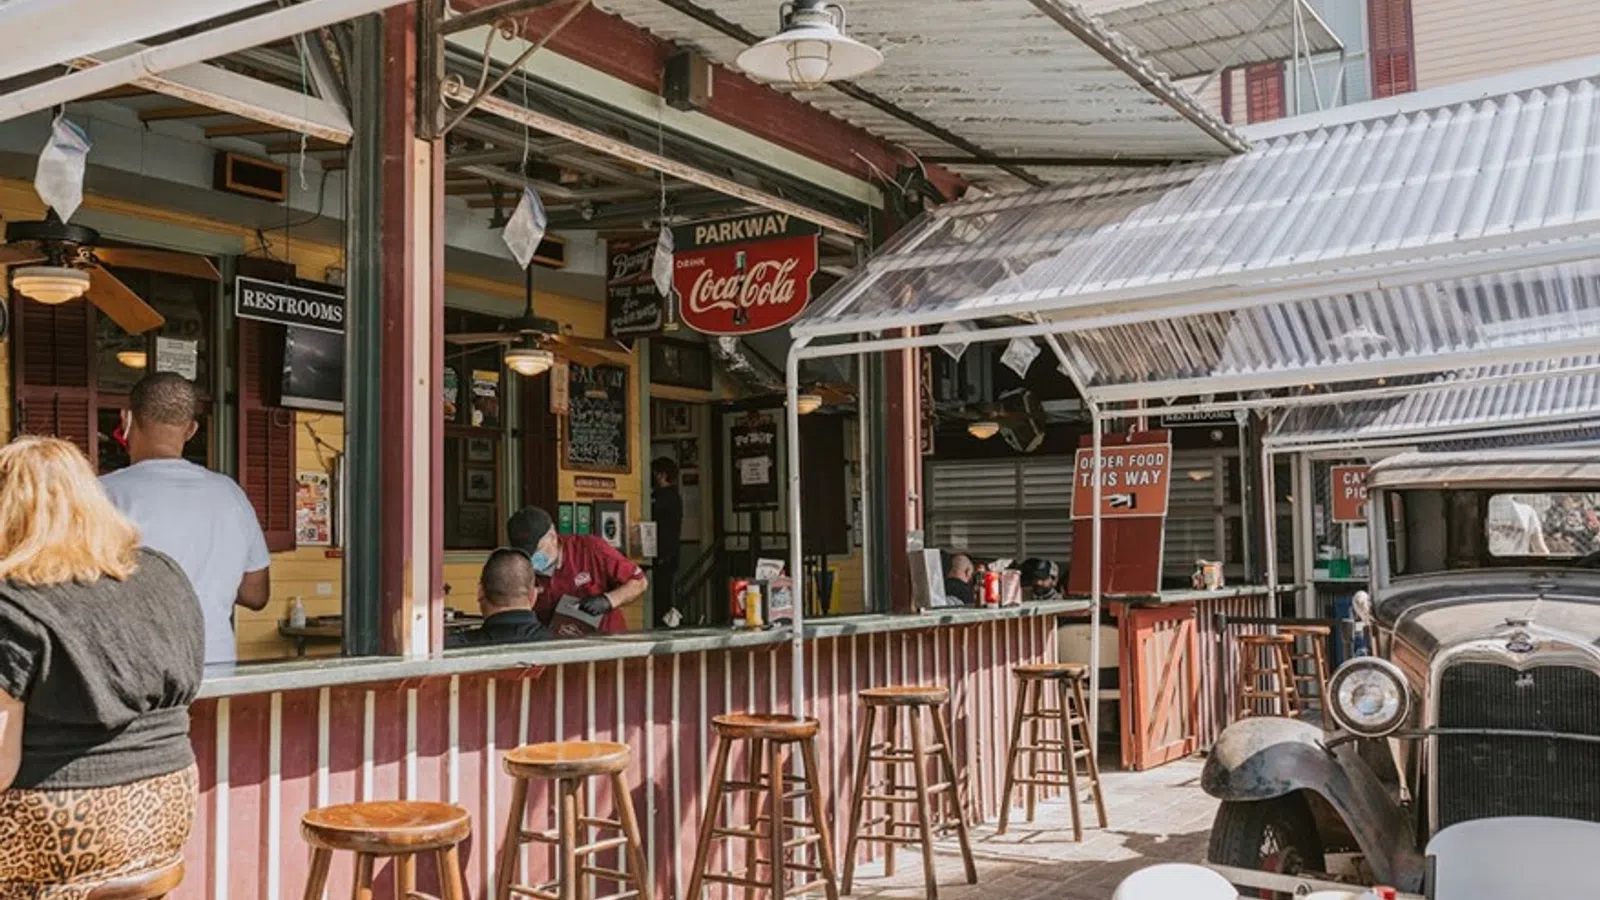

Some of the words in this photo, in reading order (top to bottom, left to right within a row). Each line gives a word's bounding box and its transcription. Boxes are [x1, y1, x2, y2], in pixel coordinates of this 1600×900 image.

[695, 214, 790, 245] PARKWAY
[676, 257, 706, 269] DRINK
[690, 257, 800, 313] Coca-Cola
[243, 289, 343, 322] RESTROOMS
[1129, 453, 1164, 467] FOOD
[1125, 470, 1161, 486] WAY
